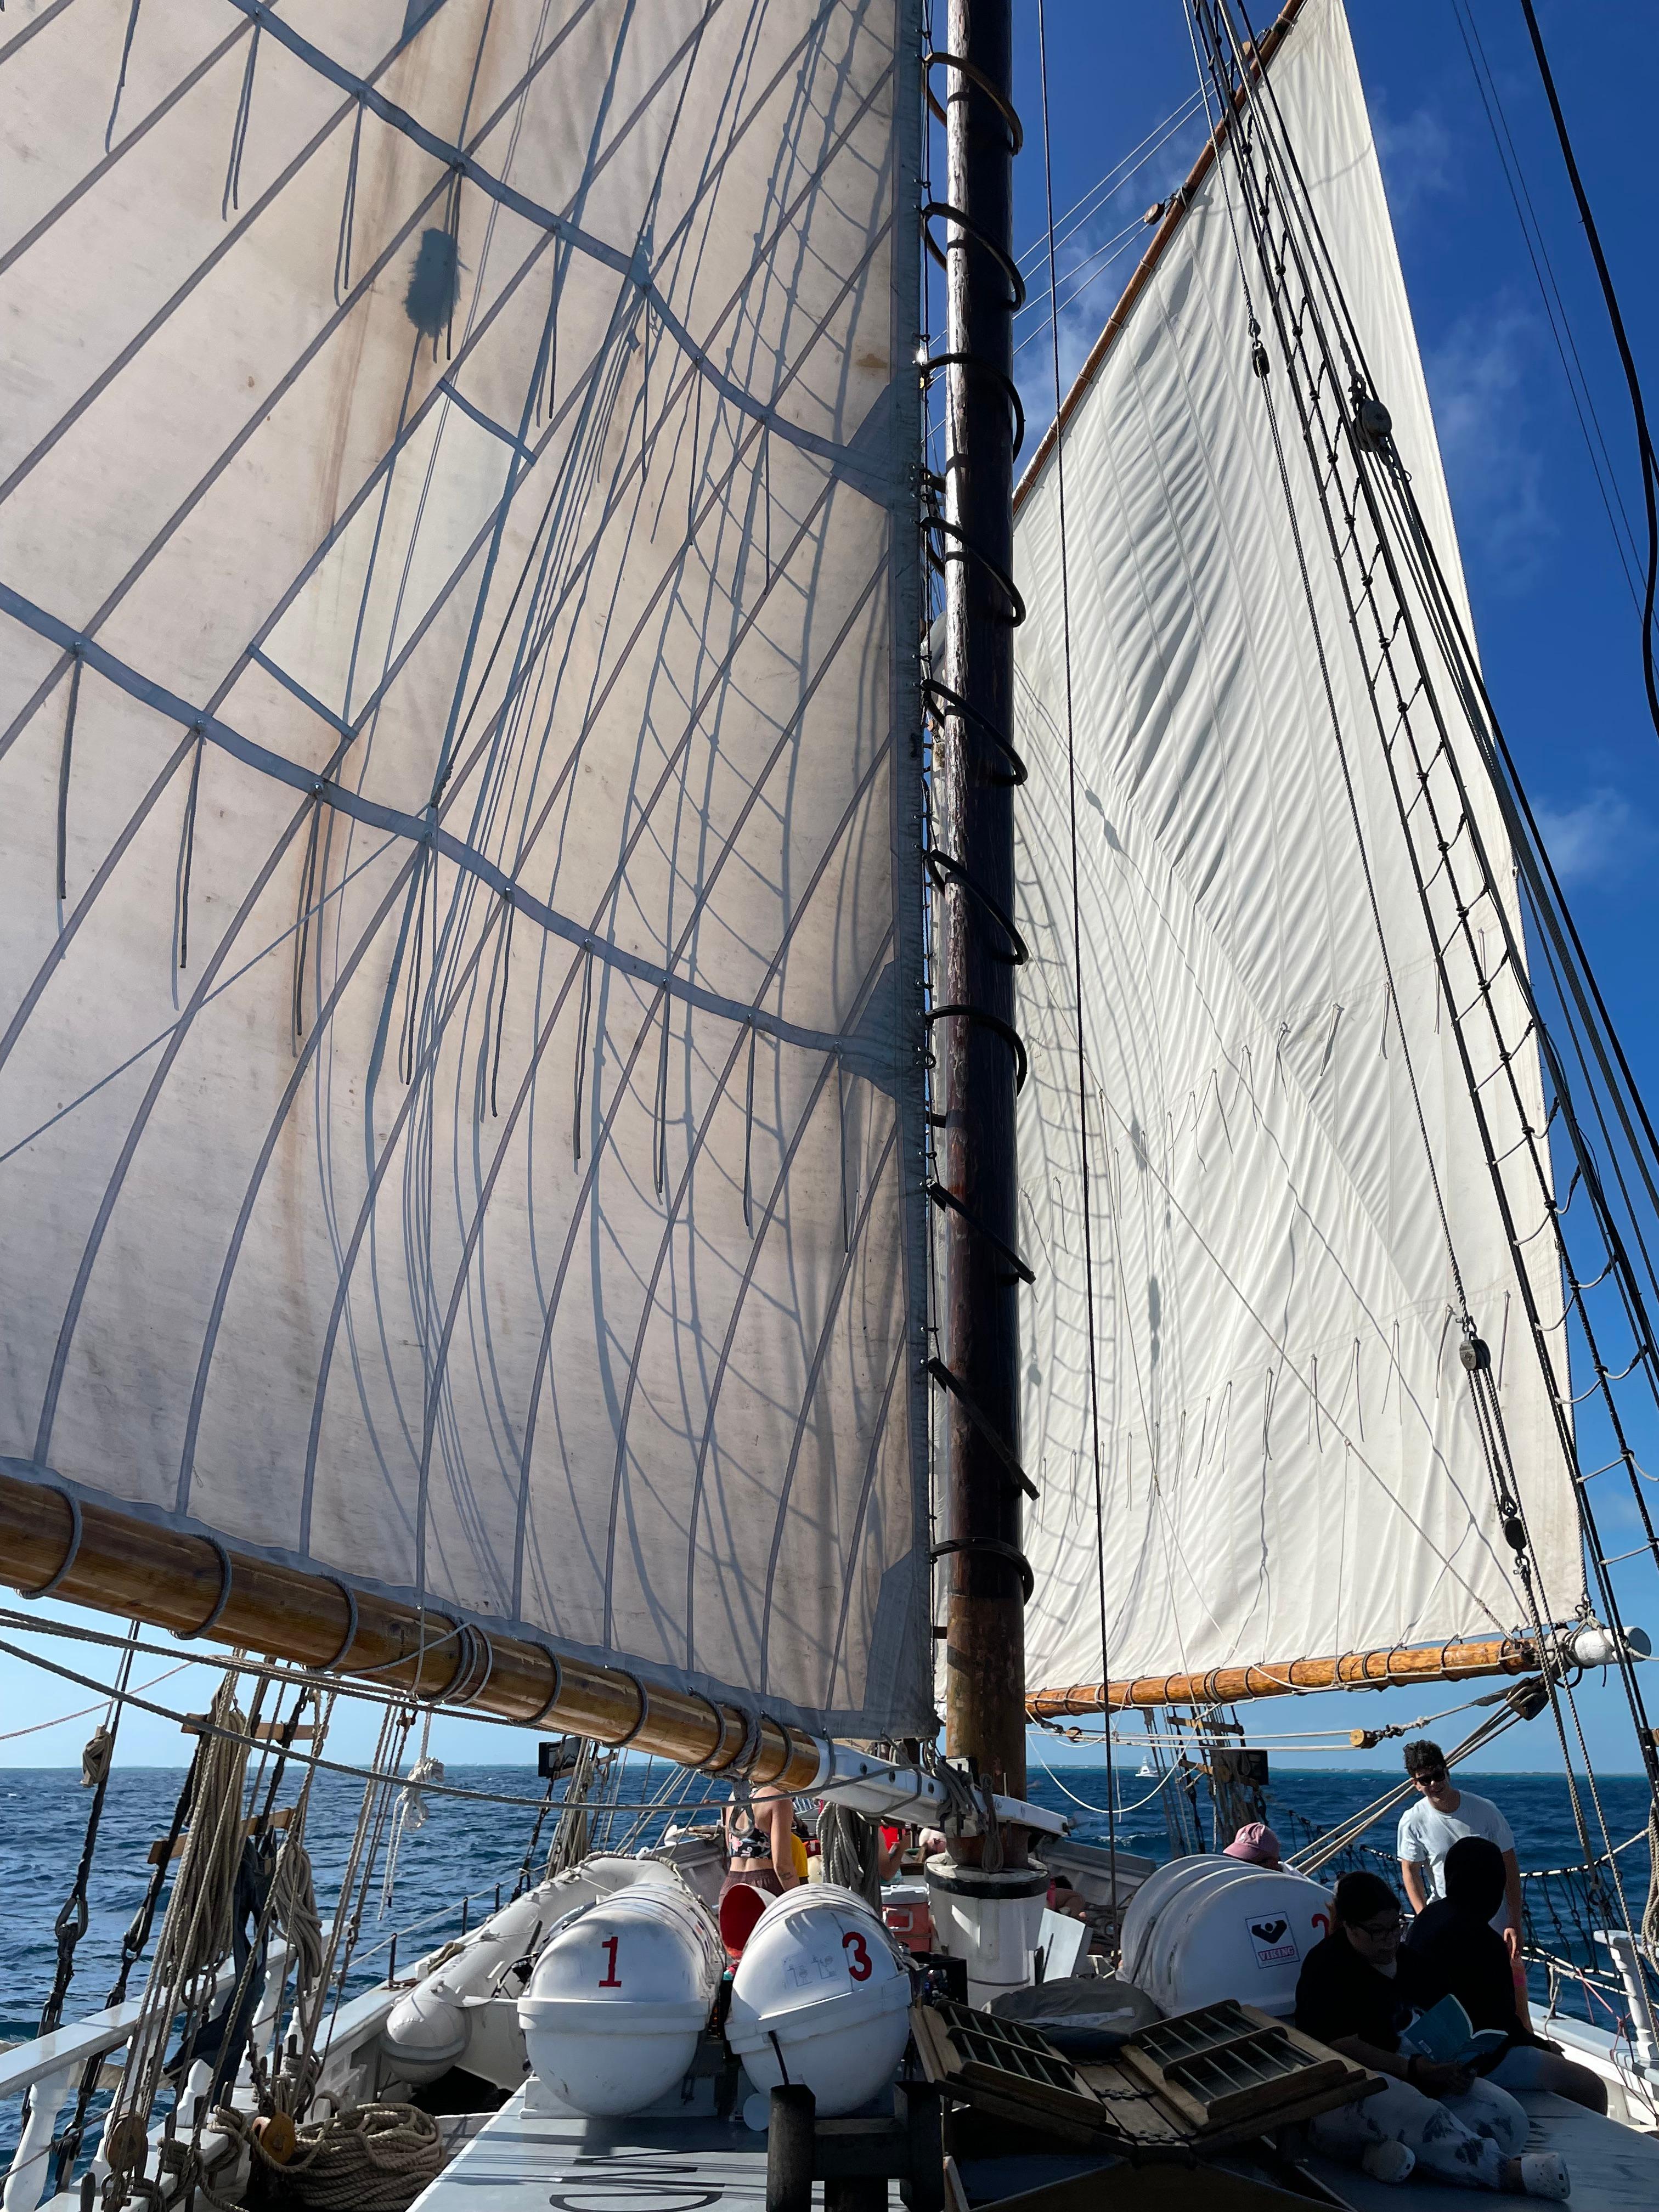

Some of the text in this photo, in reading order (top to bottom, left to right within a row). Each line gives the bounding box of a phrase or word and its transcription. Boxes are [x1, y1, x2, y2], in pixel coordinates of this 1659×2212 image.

[598, 1936, 622, 1988] 1
[842, 1931, 873, 1982] 3
[1259, 1945, 1295, 1961] VIKING
